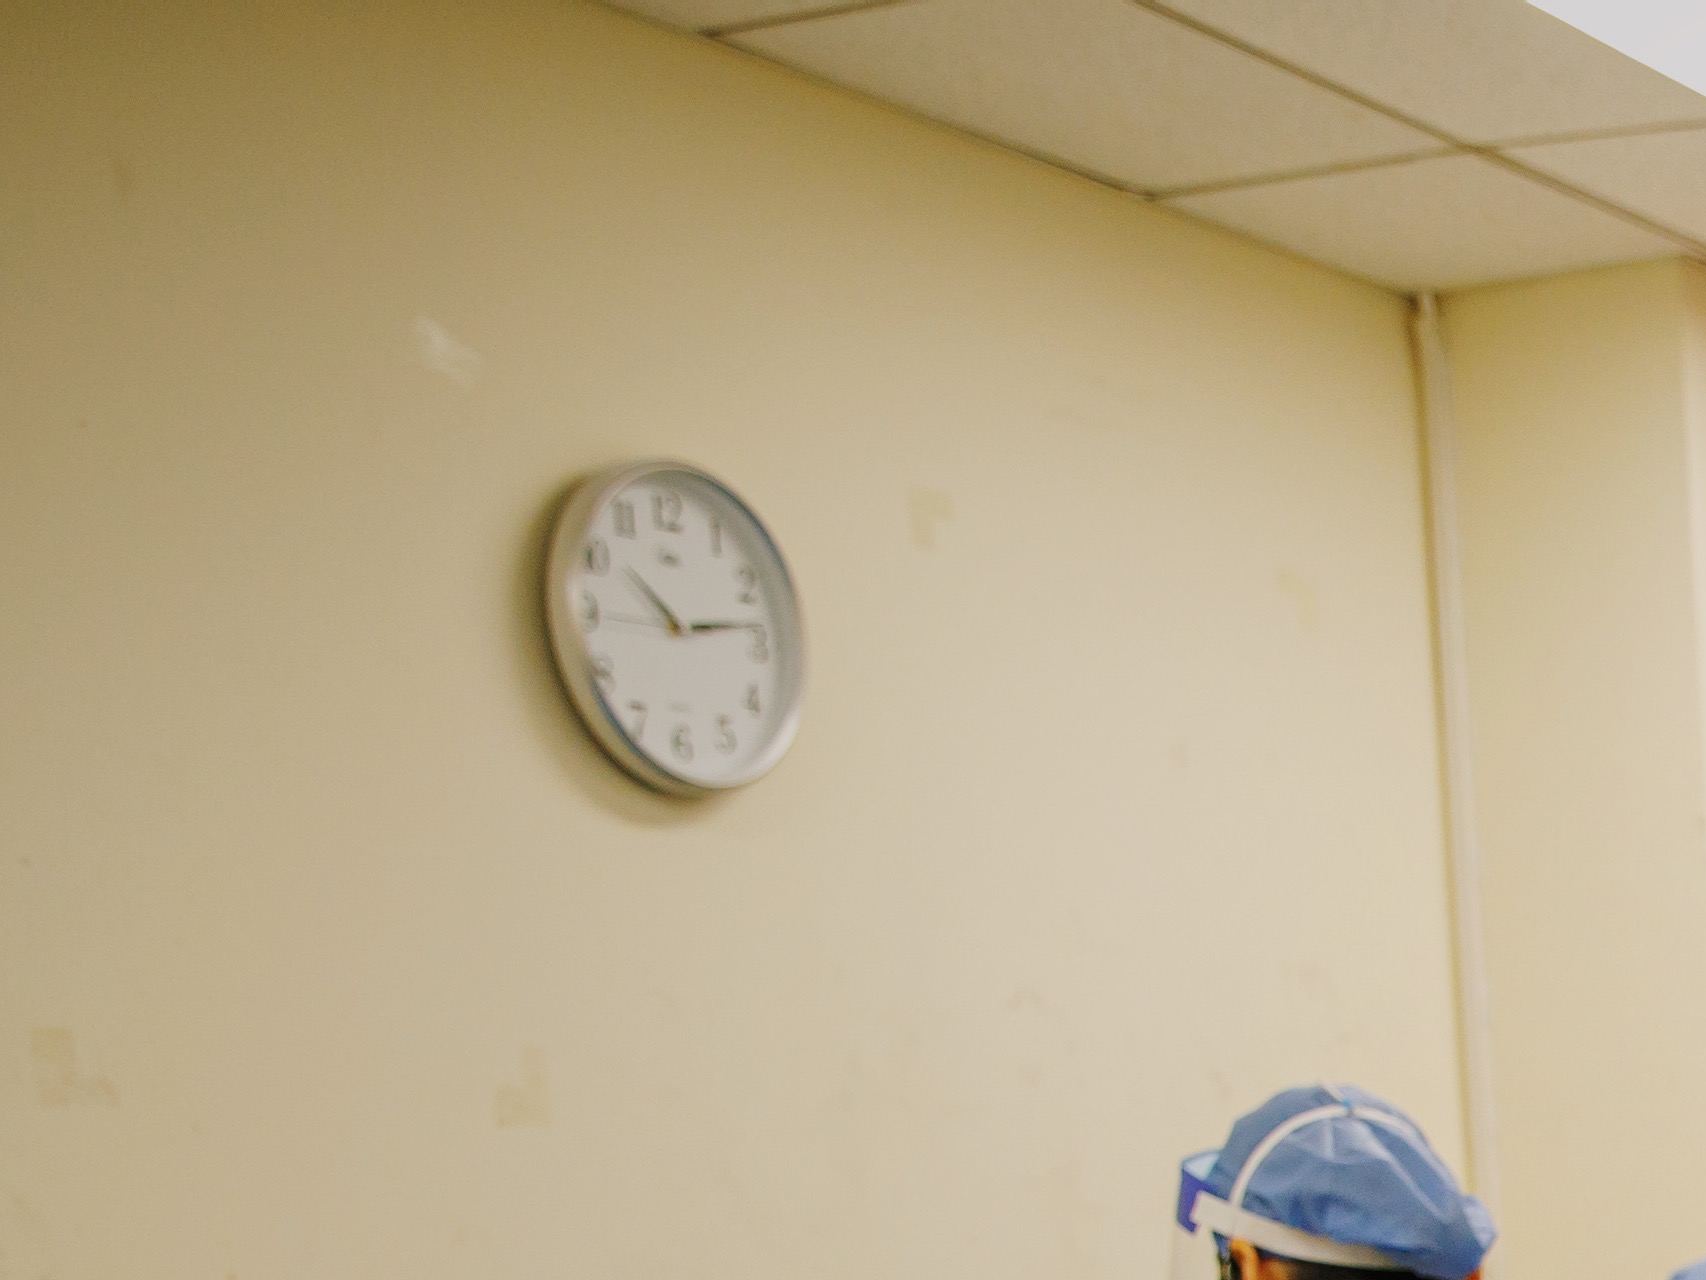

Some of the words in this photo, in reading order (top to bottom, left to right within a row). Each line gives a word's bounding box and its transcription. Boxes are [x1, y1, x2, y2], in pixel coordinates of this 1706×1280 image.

[651, 491, 684, 534] 12
[708, 516, 723, 557] 1
[737, 565, 758, 604] 2
[746, 627, 769, 664] 3
[743, 683, 762, 715] 4
[627, 699, 648, 744] 7
[714, 713, 737, 754] 5
[670, 722, 694, 762] 6
